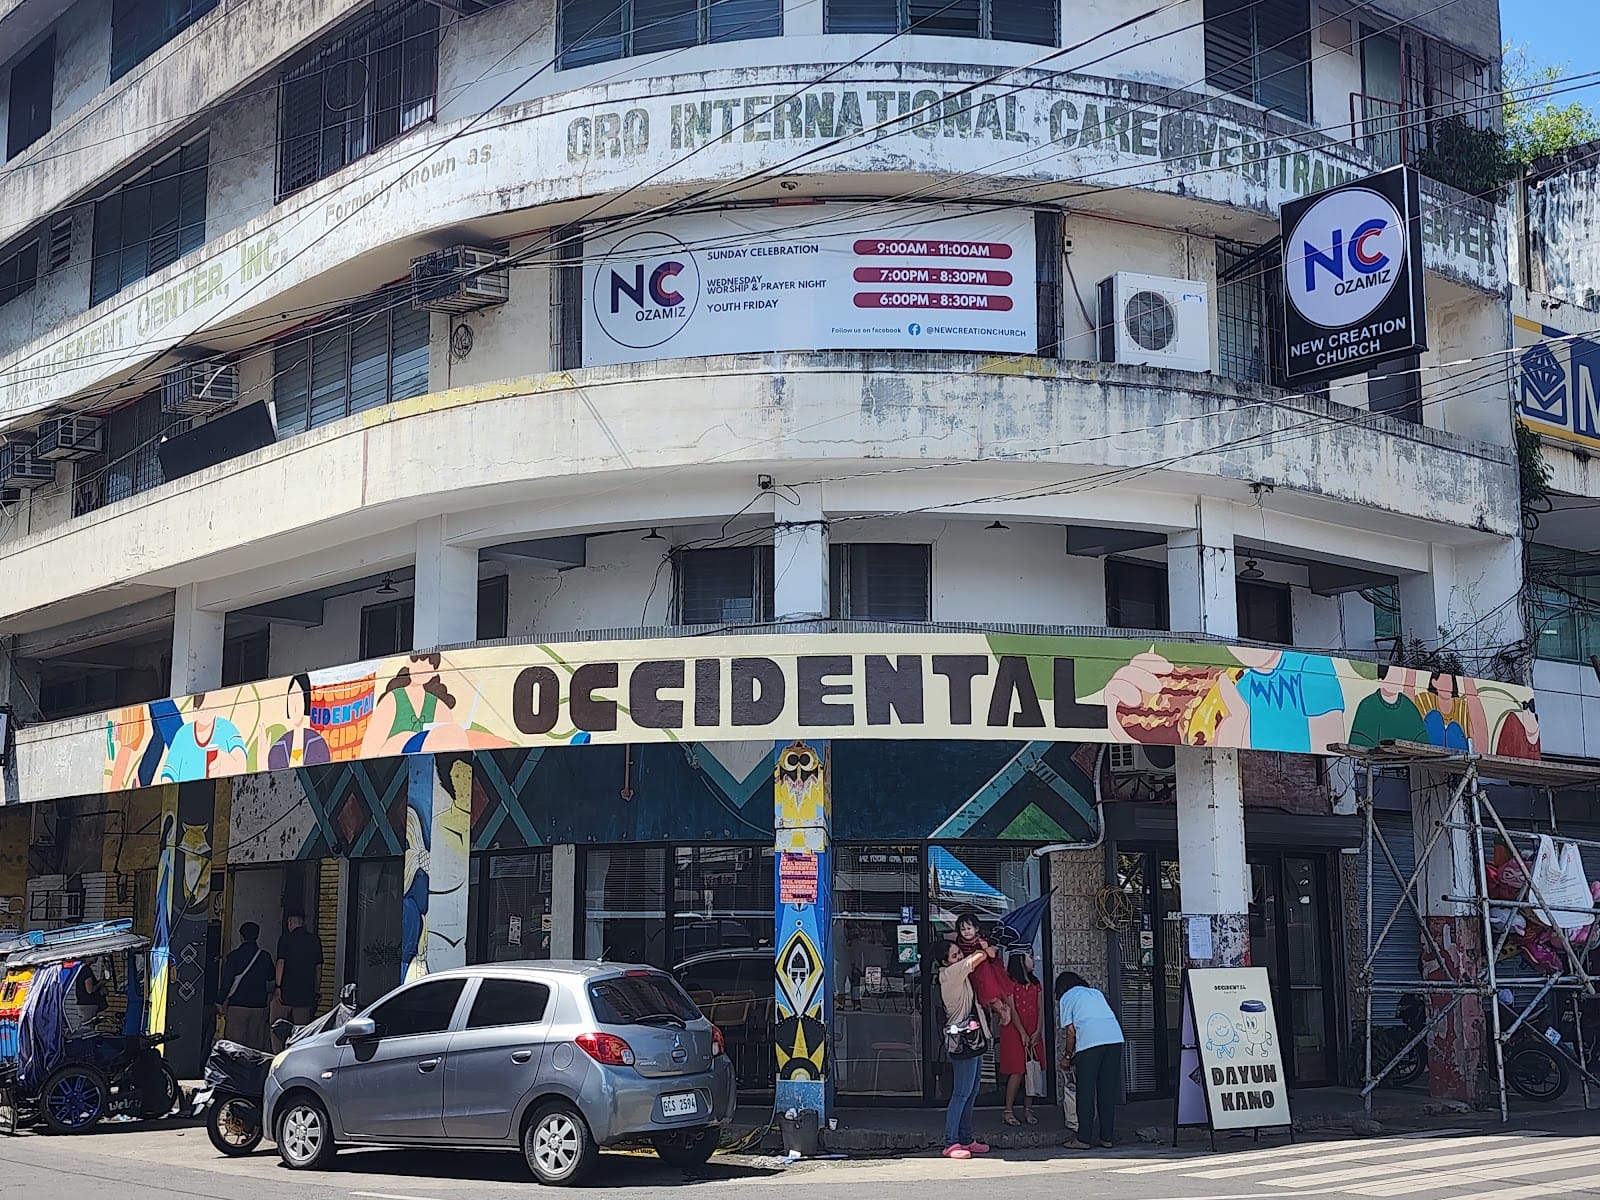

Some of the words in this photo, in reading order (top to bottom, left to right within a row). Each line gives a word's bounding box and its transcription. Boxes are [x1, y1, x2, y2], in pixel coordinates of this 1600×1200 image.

[467, 143, 493, 167] as
[567, 107, 650, 164] ORO
[670, 89, 1030, 150] INTERNATIONAL
[1049, 99, 1264, 184] CAREGIVER
[1272, 143, 1359, 196] TRAIN
[1421, 214, 1495, 266] ENTER
[239, 231, 289, 283] INC.
[707, 248, 748, 261] SUNDAY
[749, 244, 819, 258] CELEBRATION
[877, 242, 928, 254] 9:00AM
[938, 243, 990, 257] 11:00AM
[707, 275, 763, 287] WEDNESDAY
[879, 269, 929, 282] 7:00PM
[939, 271, 988, 284] 8:30PM
[1334, 269, 1392, 297] OZAMIZ
[707, 283, 750, 295] WORSHIP
[752, 283, 759, 291] &
[760, 281, 796, 292] PRAYER
[798, 279, 827, 290] NIGHT
[707, 301, 741, 314] YOUTH
[743, 299, 779, 311] FRIDAY
[879, 293, 929, 306] 6:00PM
[939, 294, 988, 308] 8:30PM
[635, 306, 686, 322] OZAMIZ
[926, 325, 1026, 338] @NEWCREATIONCHURCH
[1290, 337, 1325, 358] NEW
[1327, 315, 1407, 349] CREATION
[1315, 338, 1381, 367] CHURCH
[512, 654, 1108, 735] OCCIDENTAL
[1210, 1063, 1278, 1087] DAYUN
[680, 1097, 696, 1111] 2594
[1220, 1089, 1276, 1112] KAMO
